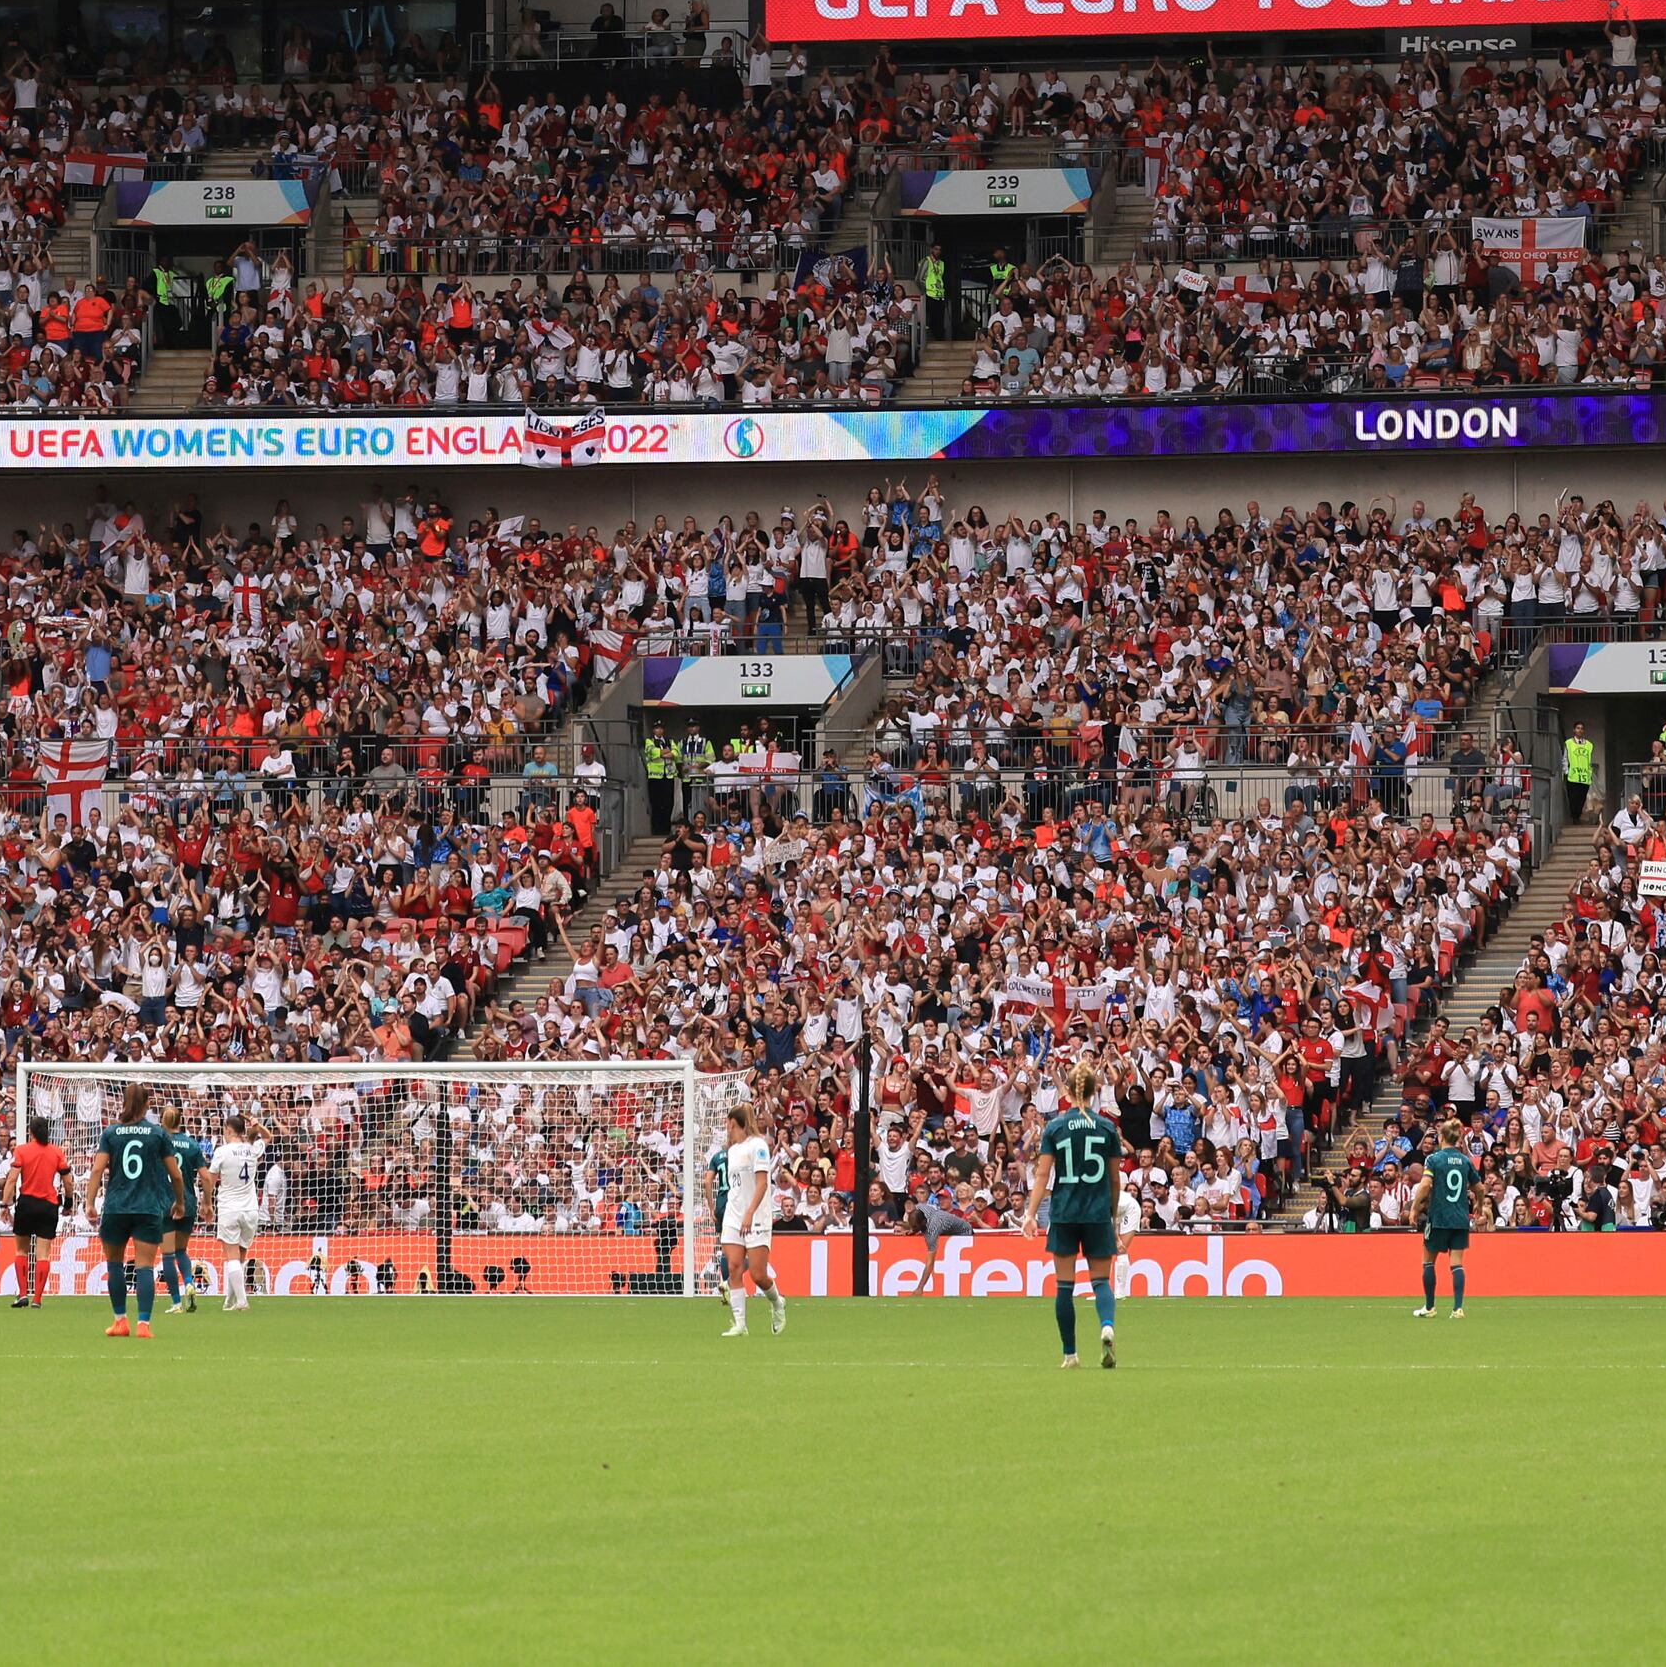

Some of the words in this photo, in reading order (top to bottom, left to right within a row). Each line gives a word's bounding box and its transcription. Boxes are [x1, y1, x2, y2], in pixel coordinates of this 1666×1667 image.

[203, 187, 235, 200] 238
[986, 175, 1019, 190] 239
[1476, 228, 1519, 240] SWANS
[1355, 407, 1518, 440] LONDON
[10, 430, 103, 459] UEFA
[113, 428, 285, 459] WOMEN'S
[294, 427, 394, 457] EURO
[407, 427, 524, 457] ENGLA
[602, 425, 669, 454] 022
[740, 662, 773, 677] 133
[115, 1126, 152, 1136] OBERDORF
[1068, 1118, 1096, 1130] GWINN
[122, 1139, 144, 1180] 6
[1056, 1135, 1106, 1184] 15
[238, 1162, 250, 1184] 4
[1446, 1169, 1463, 1202] 9
[809, 1234, 1282, 1297] Lieferndo
